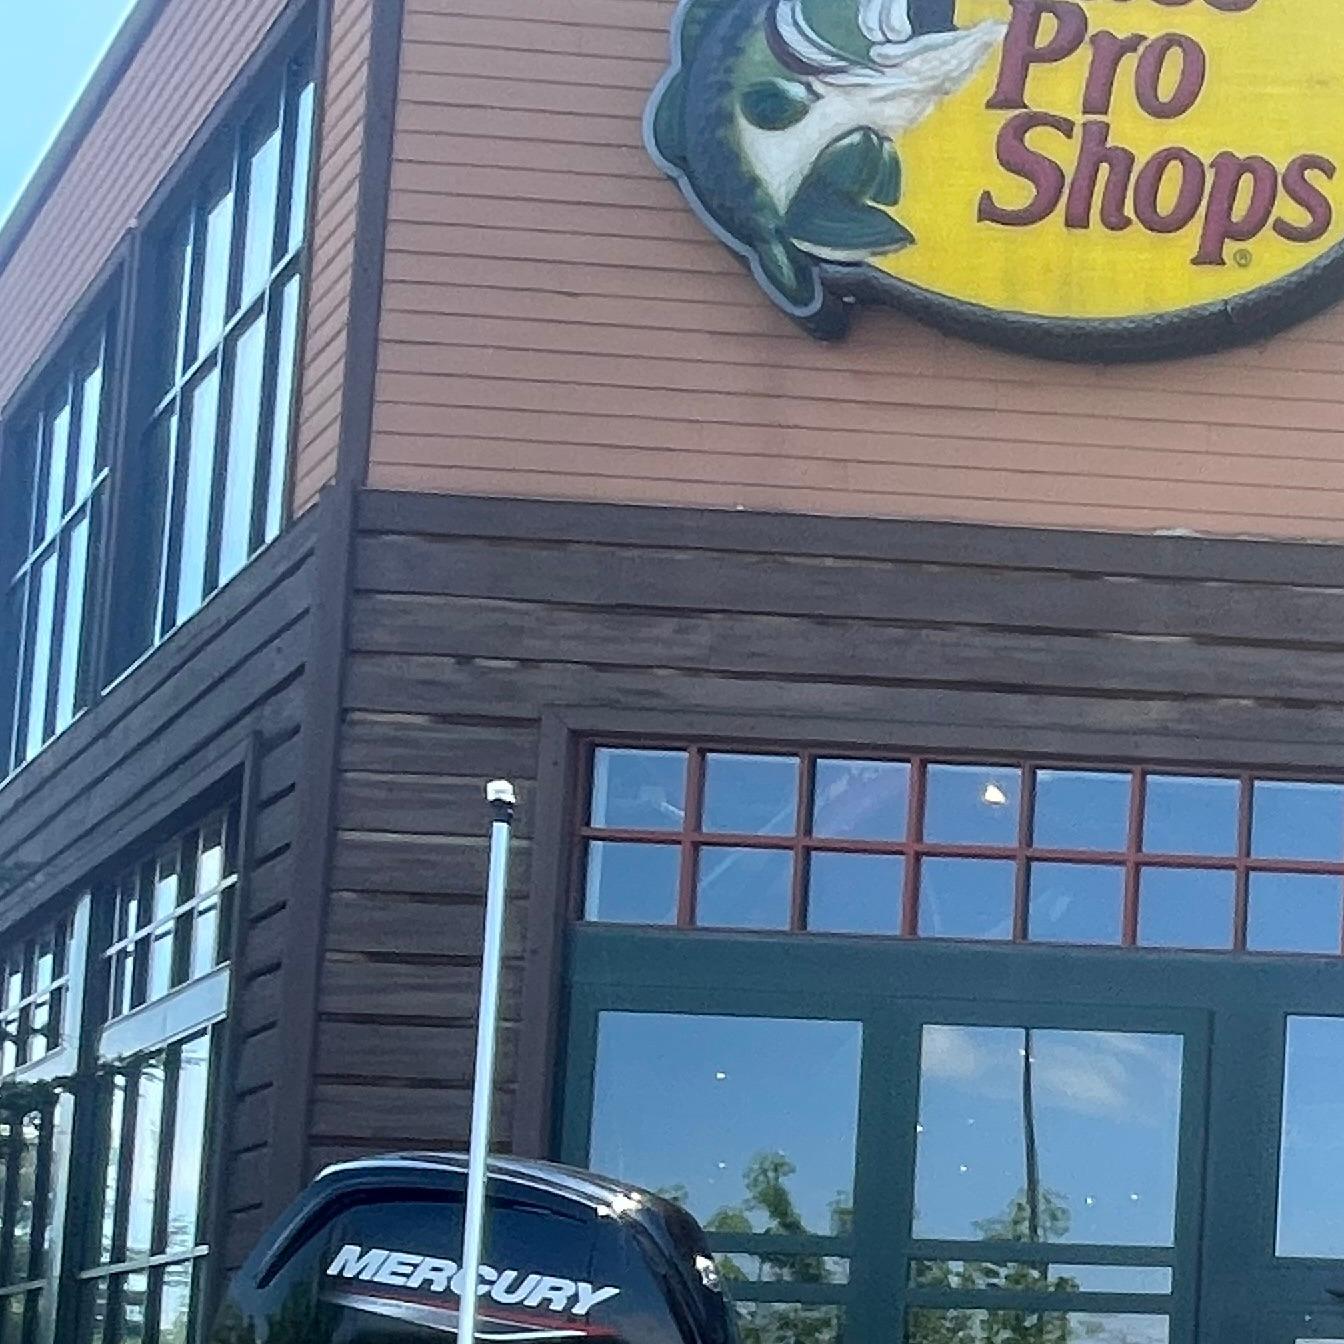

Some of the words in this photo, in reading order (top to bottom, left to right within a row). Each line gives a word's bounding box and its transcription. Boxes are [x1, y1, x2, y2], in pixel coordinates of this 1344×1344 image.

[984, 0, 1206, 119] Pro
[976, 110, 1337, 266] Shops
[326, 1244, 620, 1315] MERCURY
